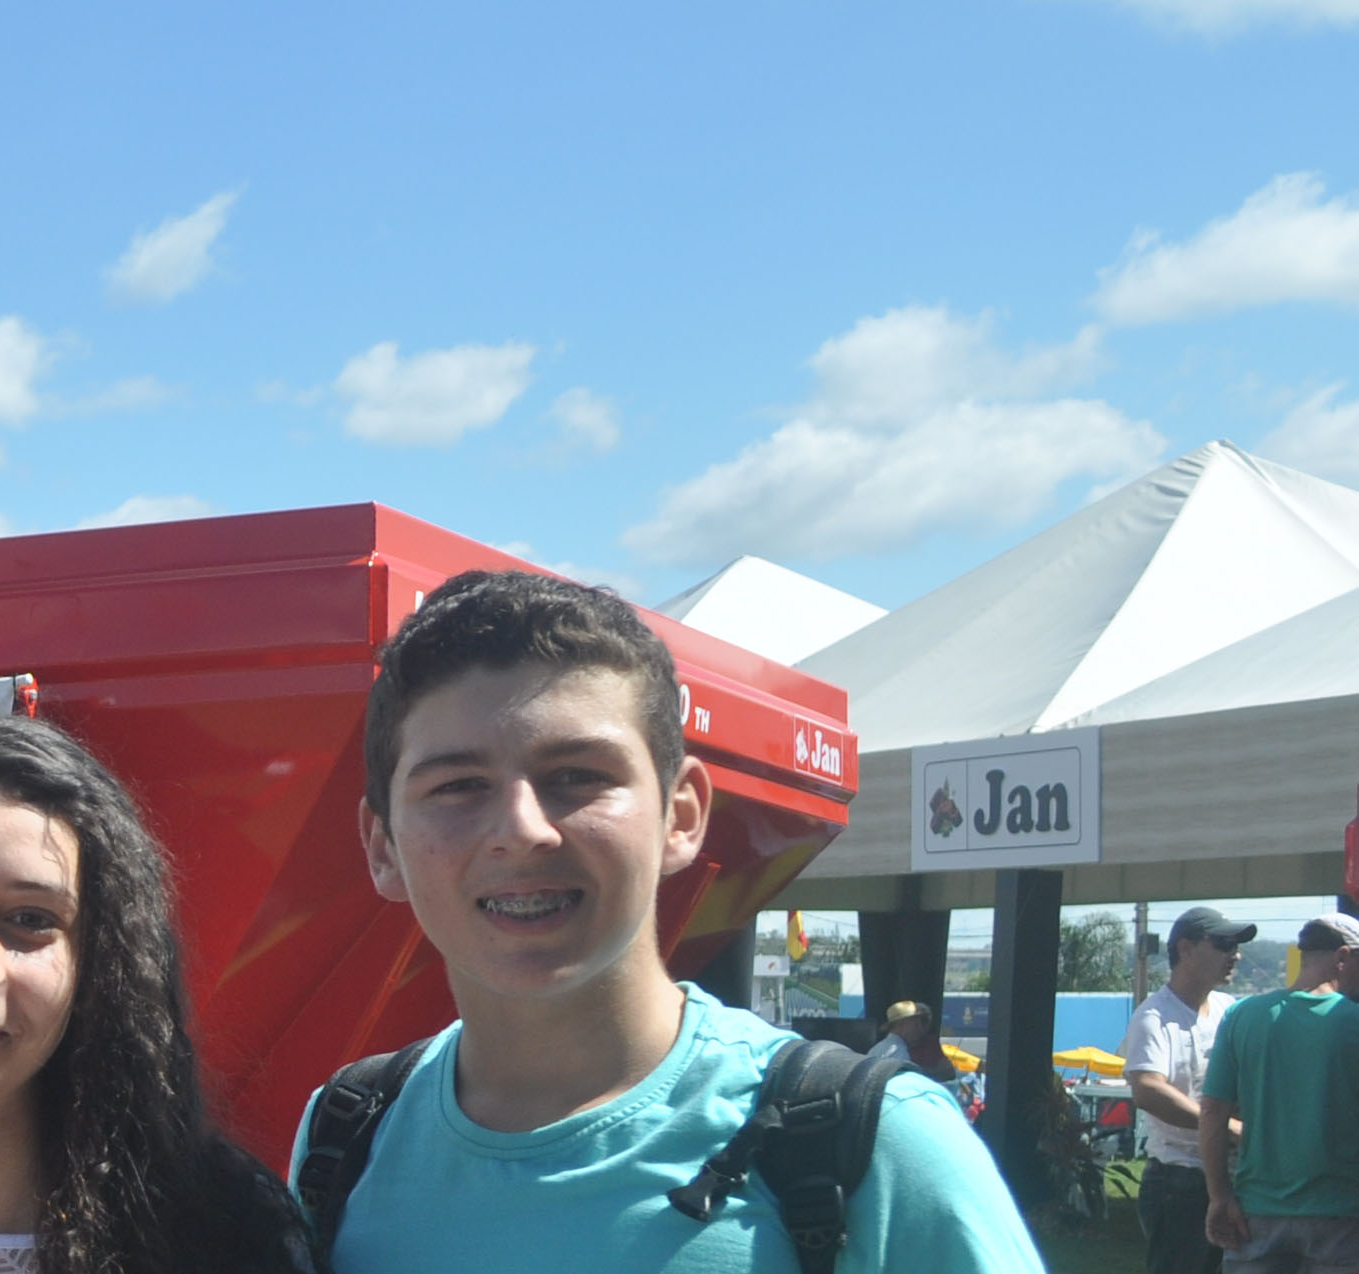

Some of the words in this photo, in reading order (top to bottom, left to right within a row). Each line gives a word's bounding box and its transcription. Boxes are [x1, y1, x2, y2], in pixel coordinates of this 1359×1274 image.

[695, 707, 710, 734] TH
[810, 730, 841, 777] Jan
[974, 769, 1072, 835] Jan
